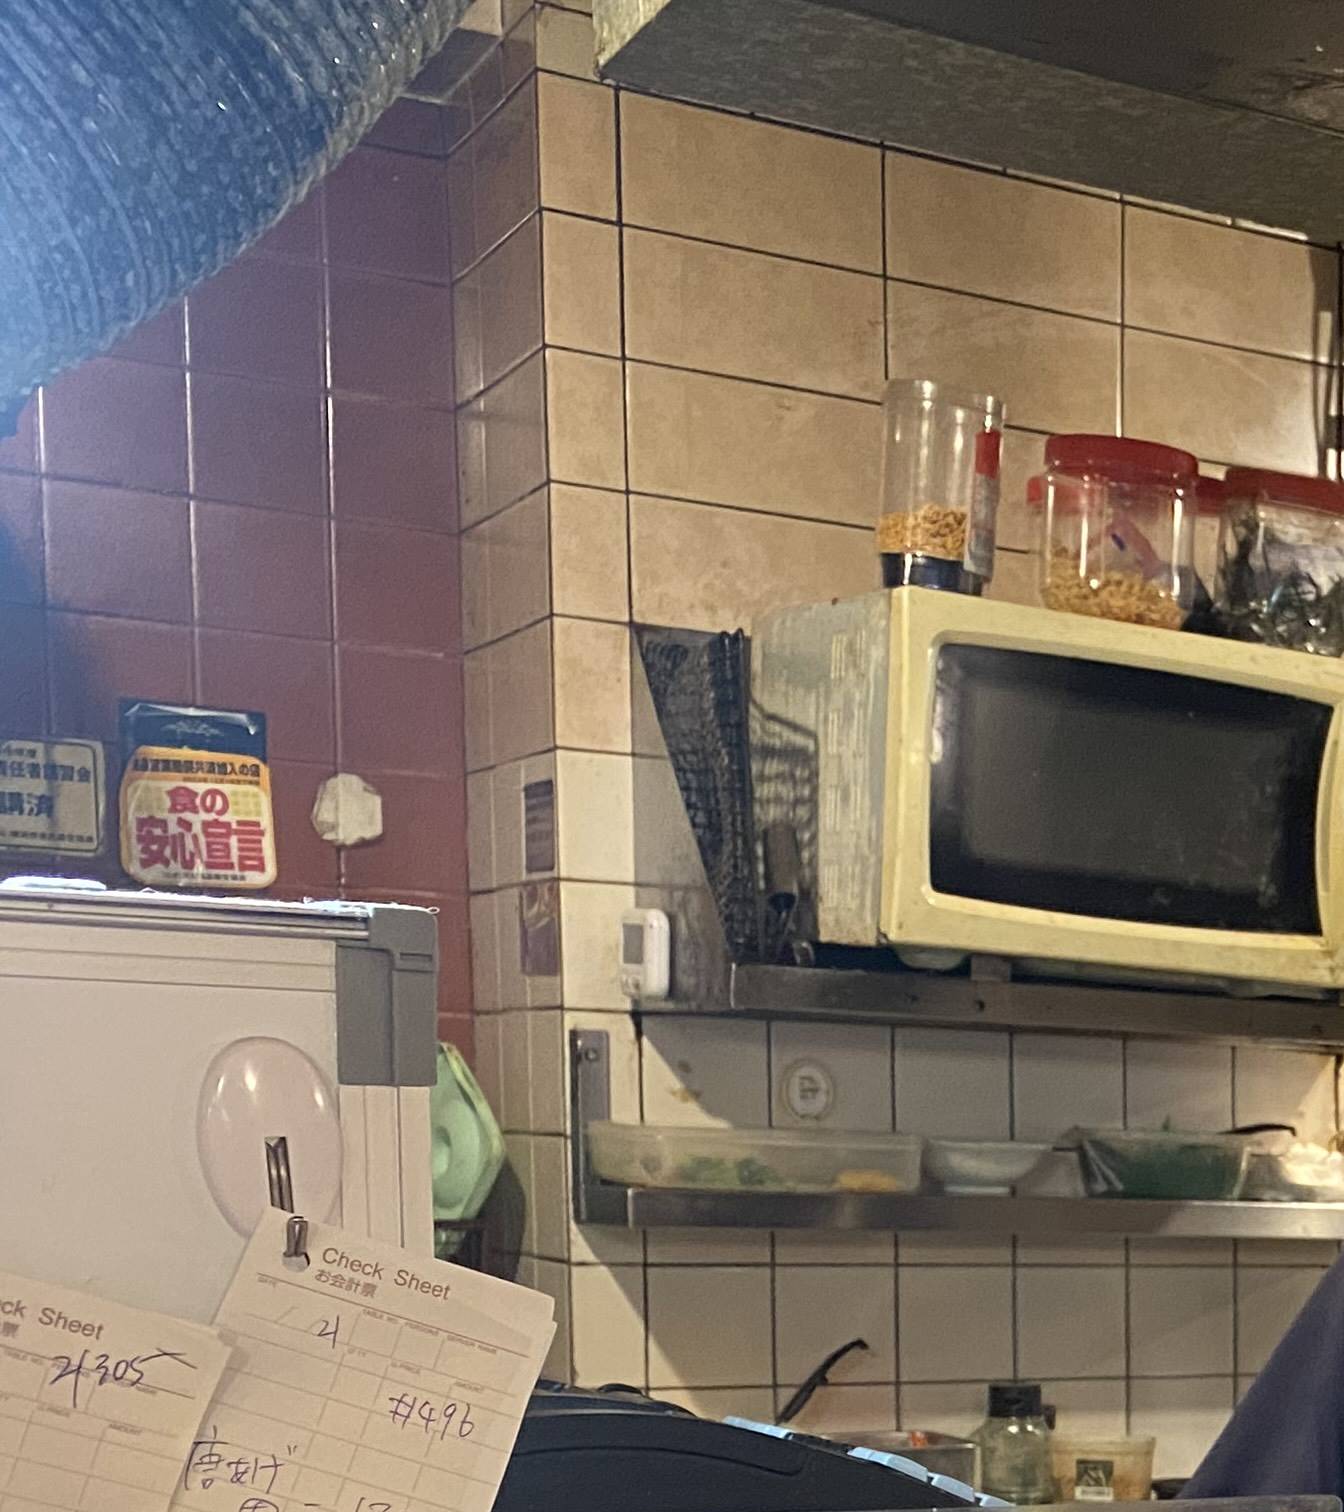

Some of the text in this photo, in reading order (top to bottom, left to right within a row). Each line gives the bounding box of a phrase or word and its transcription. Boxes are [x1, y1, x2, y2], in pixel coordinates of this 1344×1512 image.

[166, 786, 230, 816] 食の
[135, 816, 266, 872] 安心宣言
[314, 1268, 378, 1298] お会計票
[322, 1247, 450, 1300] Check Sheet
[0, 1300, 27, 1318] ck
[38, 1307, 105, 1341] Sheet
